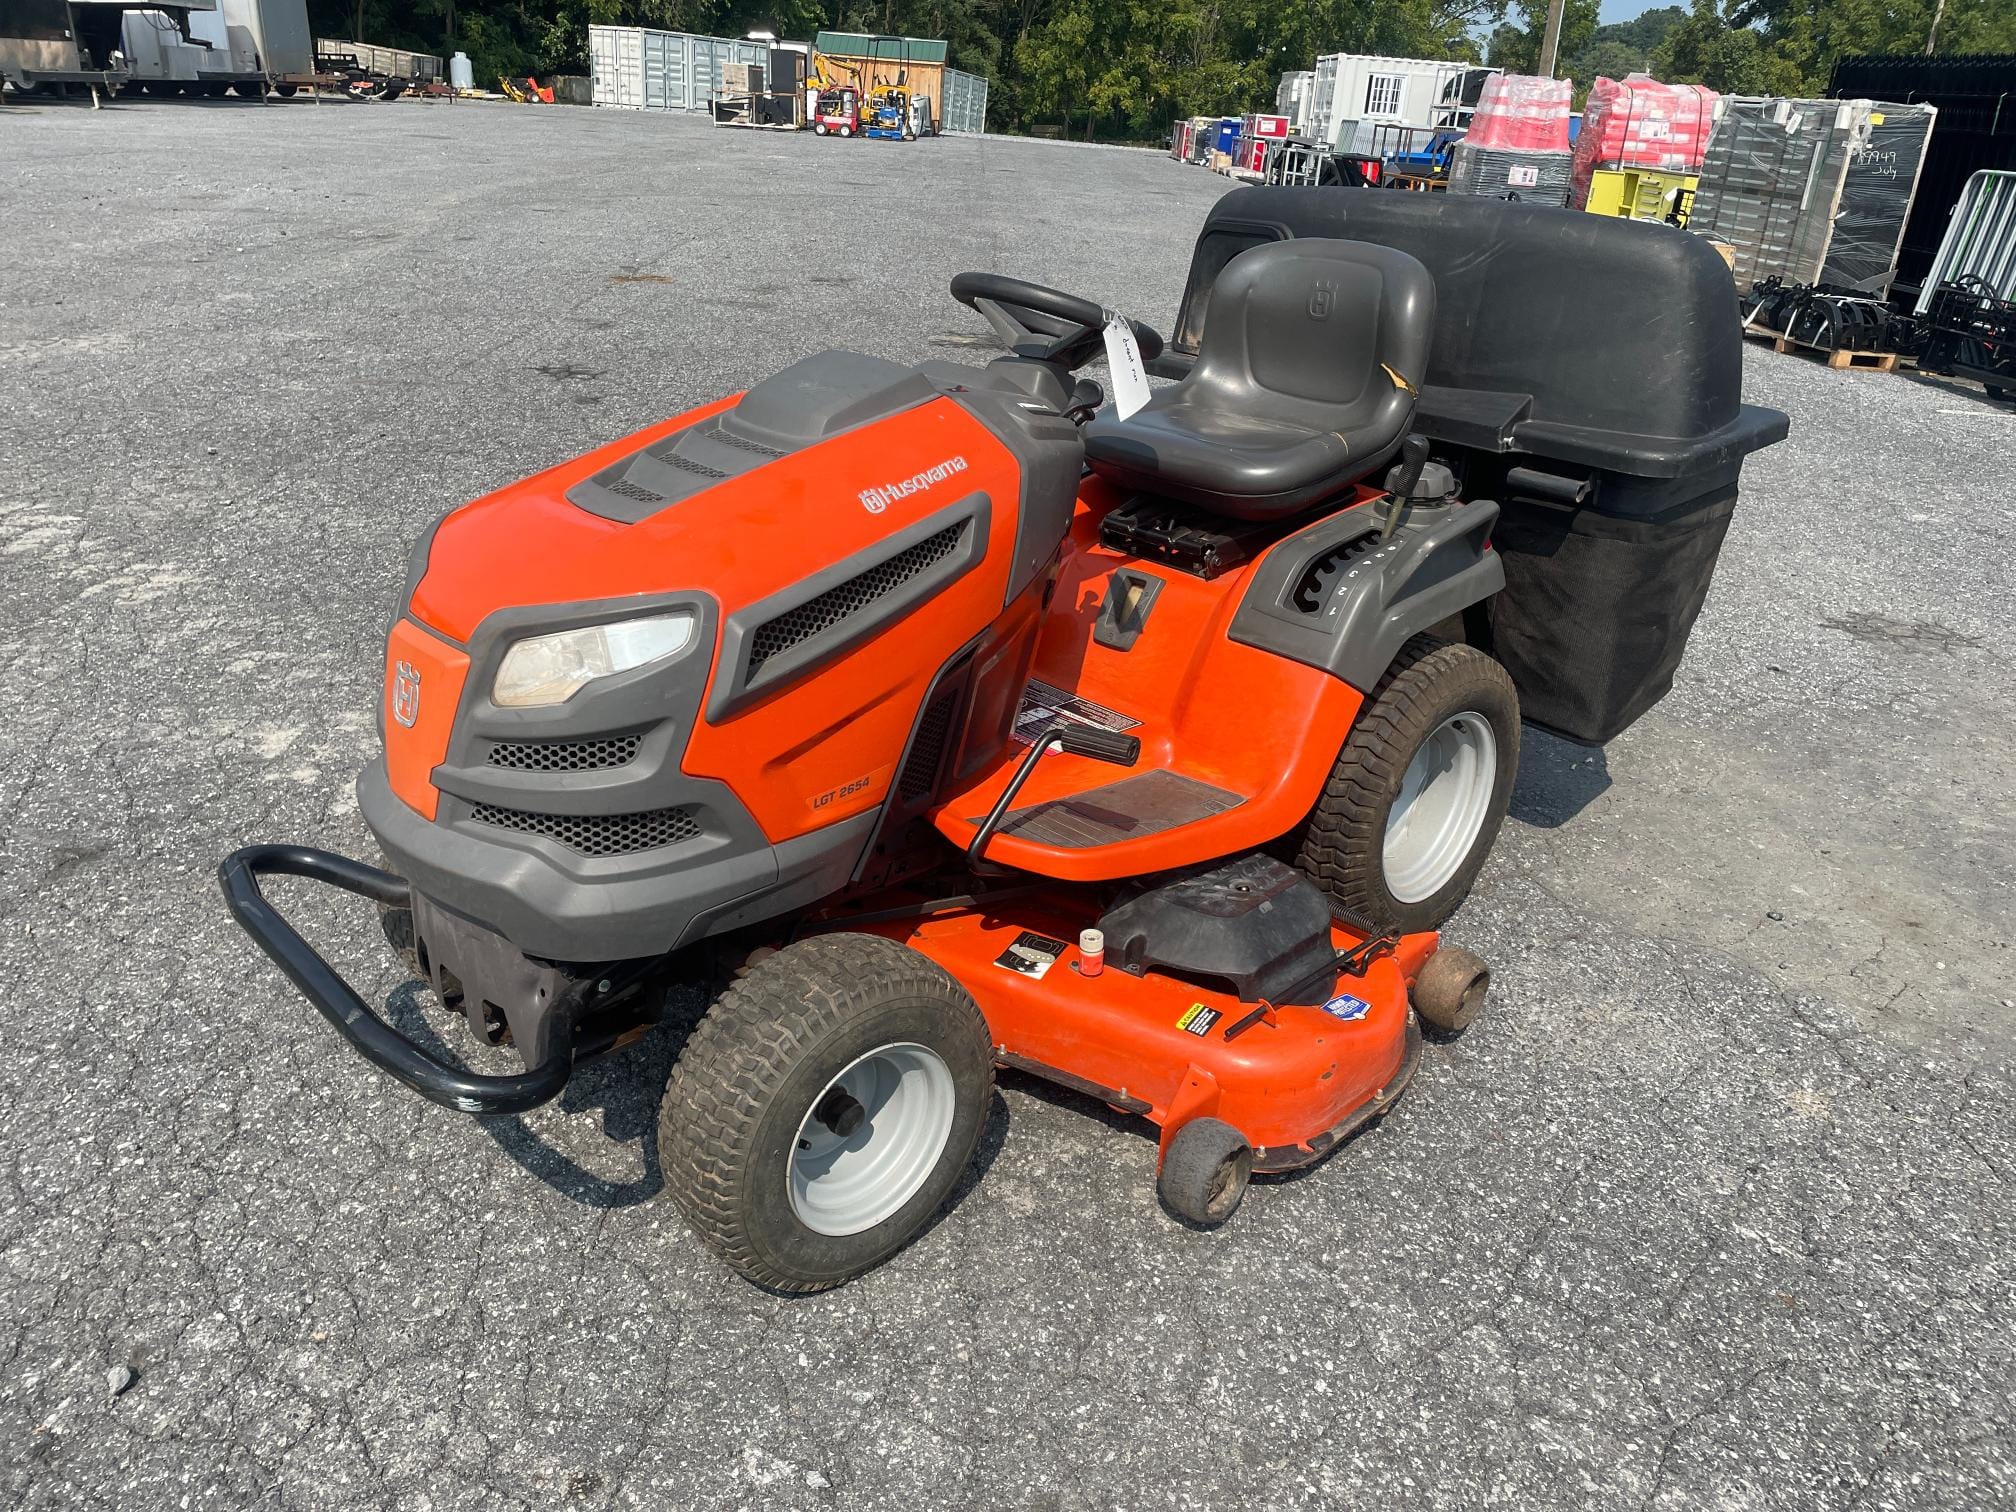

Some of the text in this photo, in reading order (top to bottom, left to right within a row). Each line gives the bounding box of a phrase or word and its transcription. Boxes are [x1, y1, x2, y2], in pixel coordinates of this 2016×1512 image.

[1871, 165, 1897, 180] July
[878, 456, 968, 504] Husqvarna
[1337, 586, 1348, 596] 2
[1328, 606, 1337, 616] 1
[814, 776, 870, 809] LGT 2654
[1184, 1004, 1201, 1022] CAUTION
